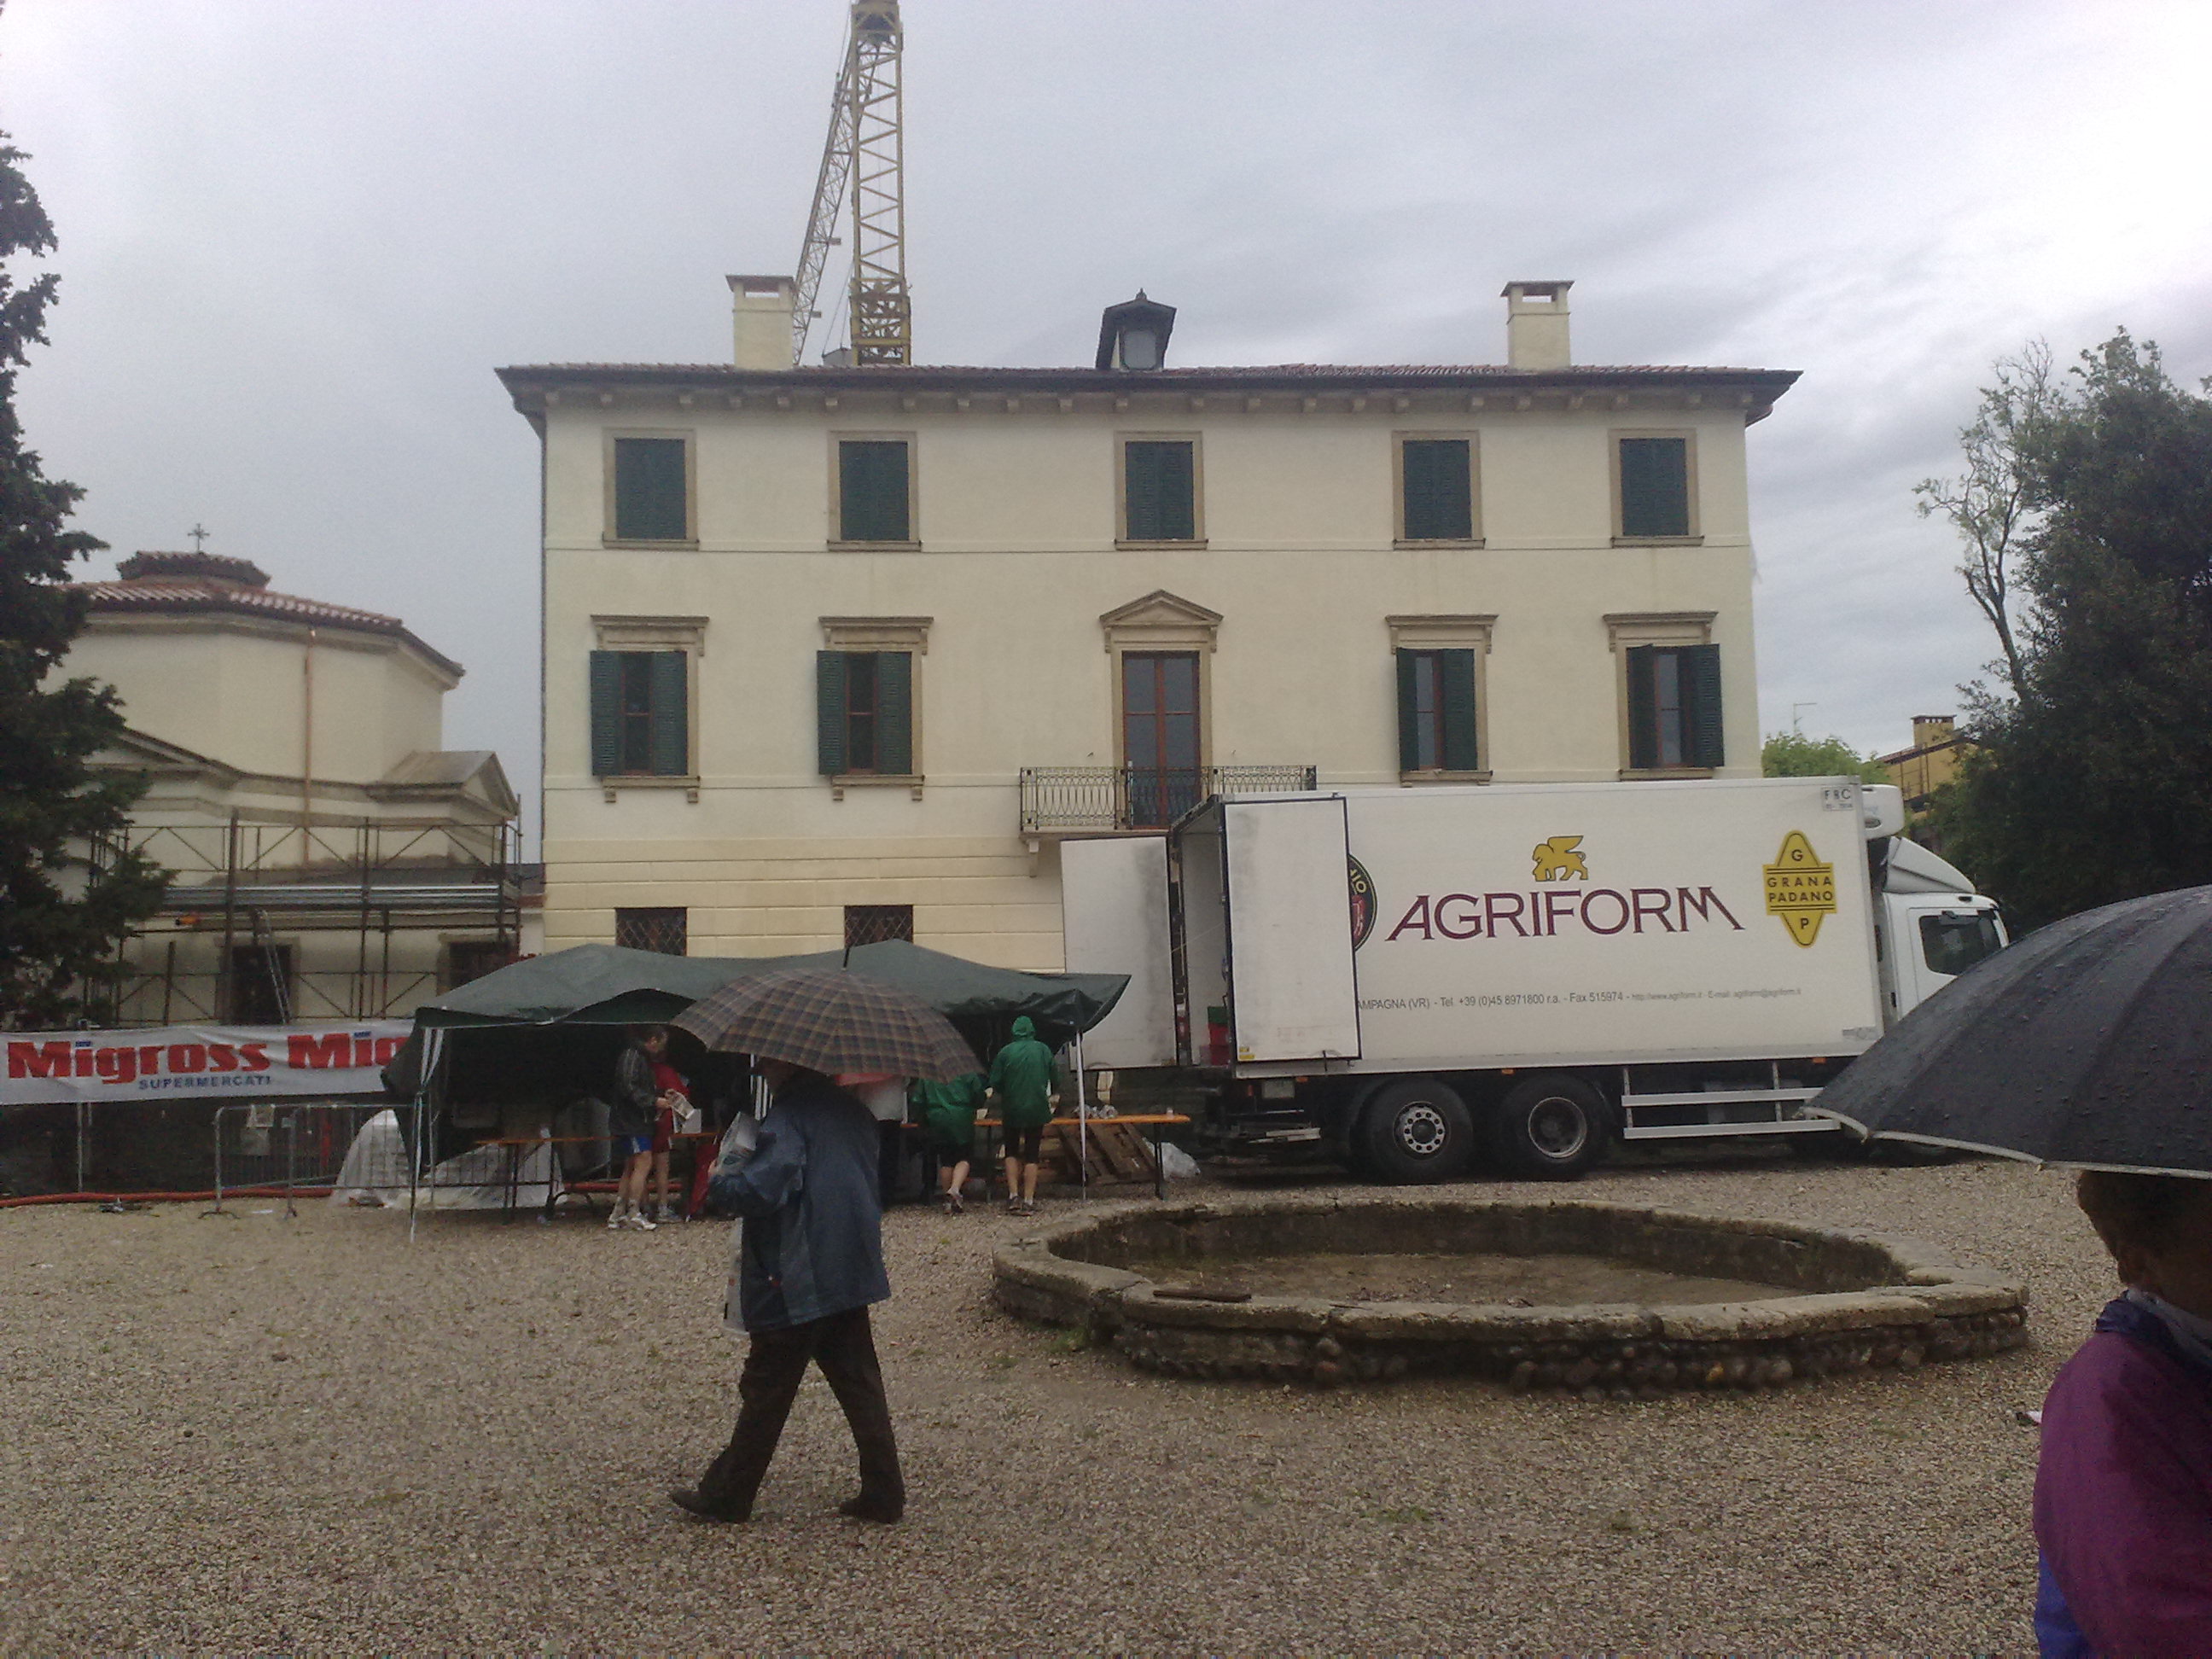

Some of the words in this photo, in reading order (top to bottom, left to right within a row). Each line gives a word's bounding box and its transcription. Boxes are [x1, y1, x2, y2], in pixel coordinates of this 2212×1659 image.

[1791, 849, 1803, 862] G
[1767, 876, 1832, 888] GRANA
[1768, 891, 1834, 902] PADANO
[1385, 886, 1746, 941] AGRIFORM
[1800, 917, 1810, 929] P
[1408, 998, 1430, 1010] (VR)
[1569, 992, 1586, 1003] Fax
[1589, 992, 1623, 1003] 515974
[8, 1041, 271, 1084] Migross
[139, 1076, 271, 1090] SUPERMERCATI
